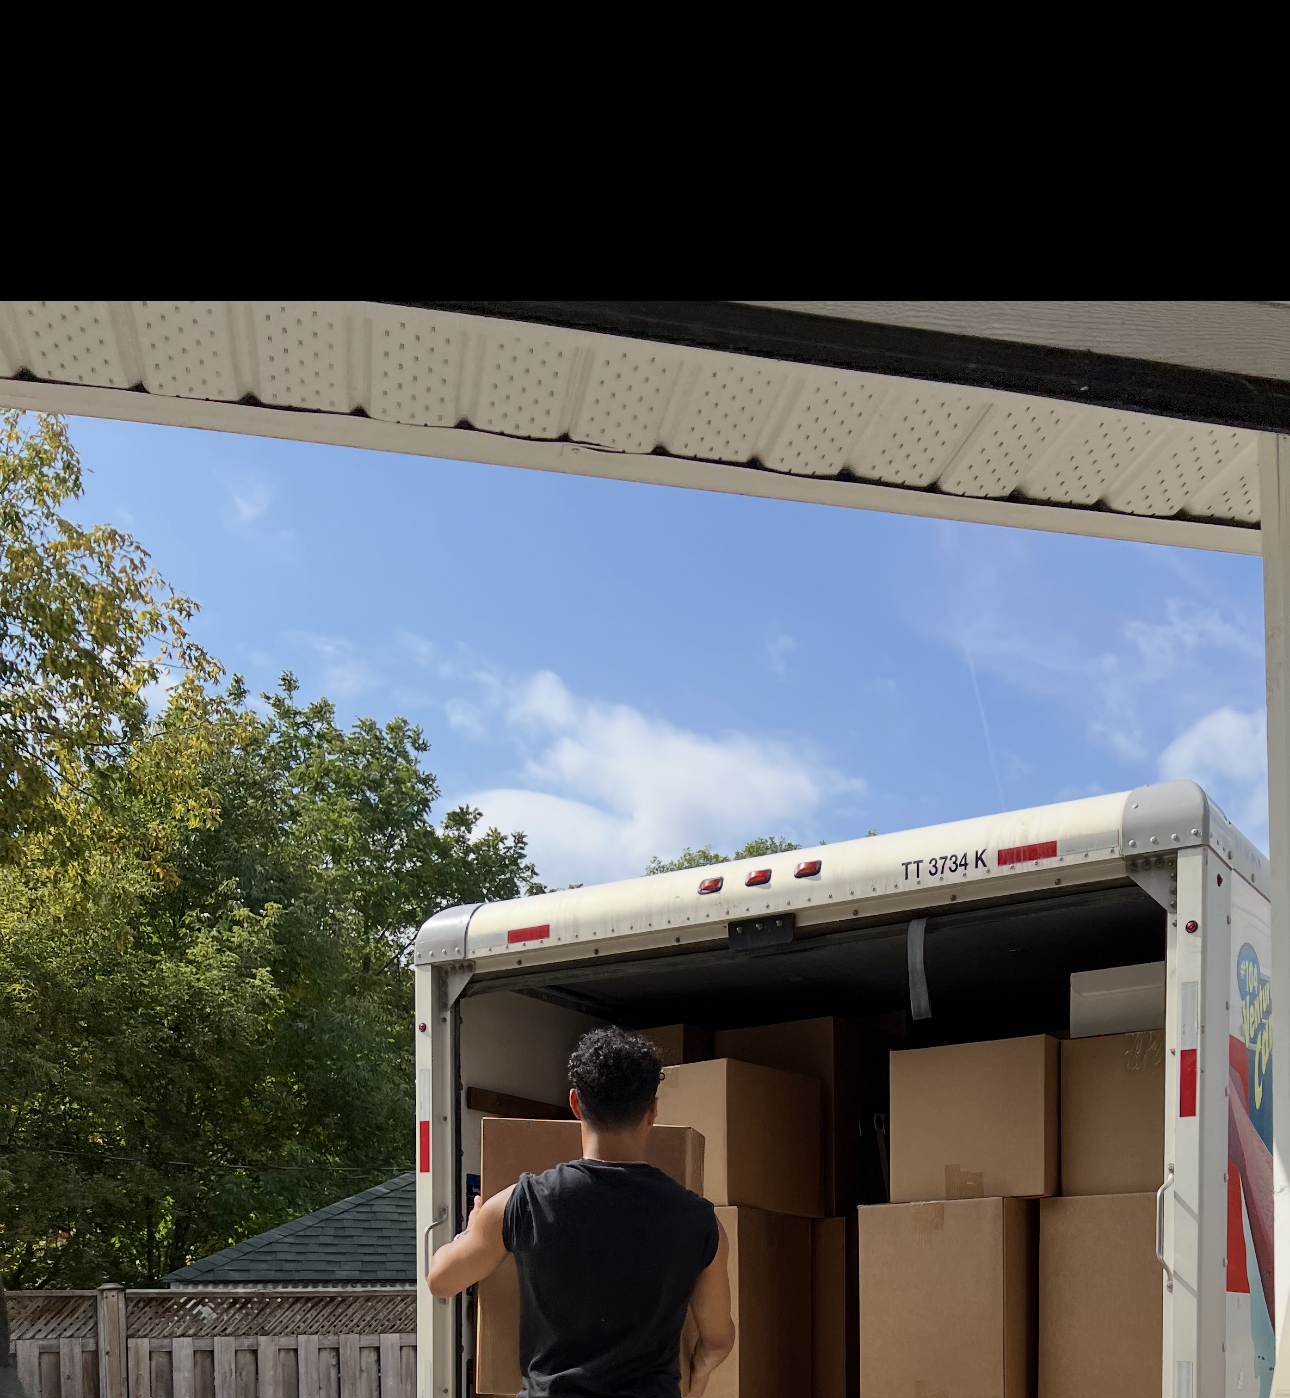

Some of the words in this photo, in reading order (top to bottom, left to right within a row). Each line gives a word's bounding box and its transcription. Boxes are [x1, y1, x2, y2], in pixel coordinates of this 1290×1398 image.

[902, 860, 924, 880] TT
[928, 852, 969, 876] 3734
[975, 848, 987, 869] K
